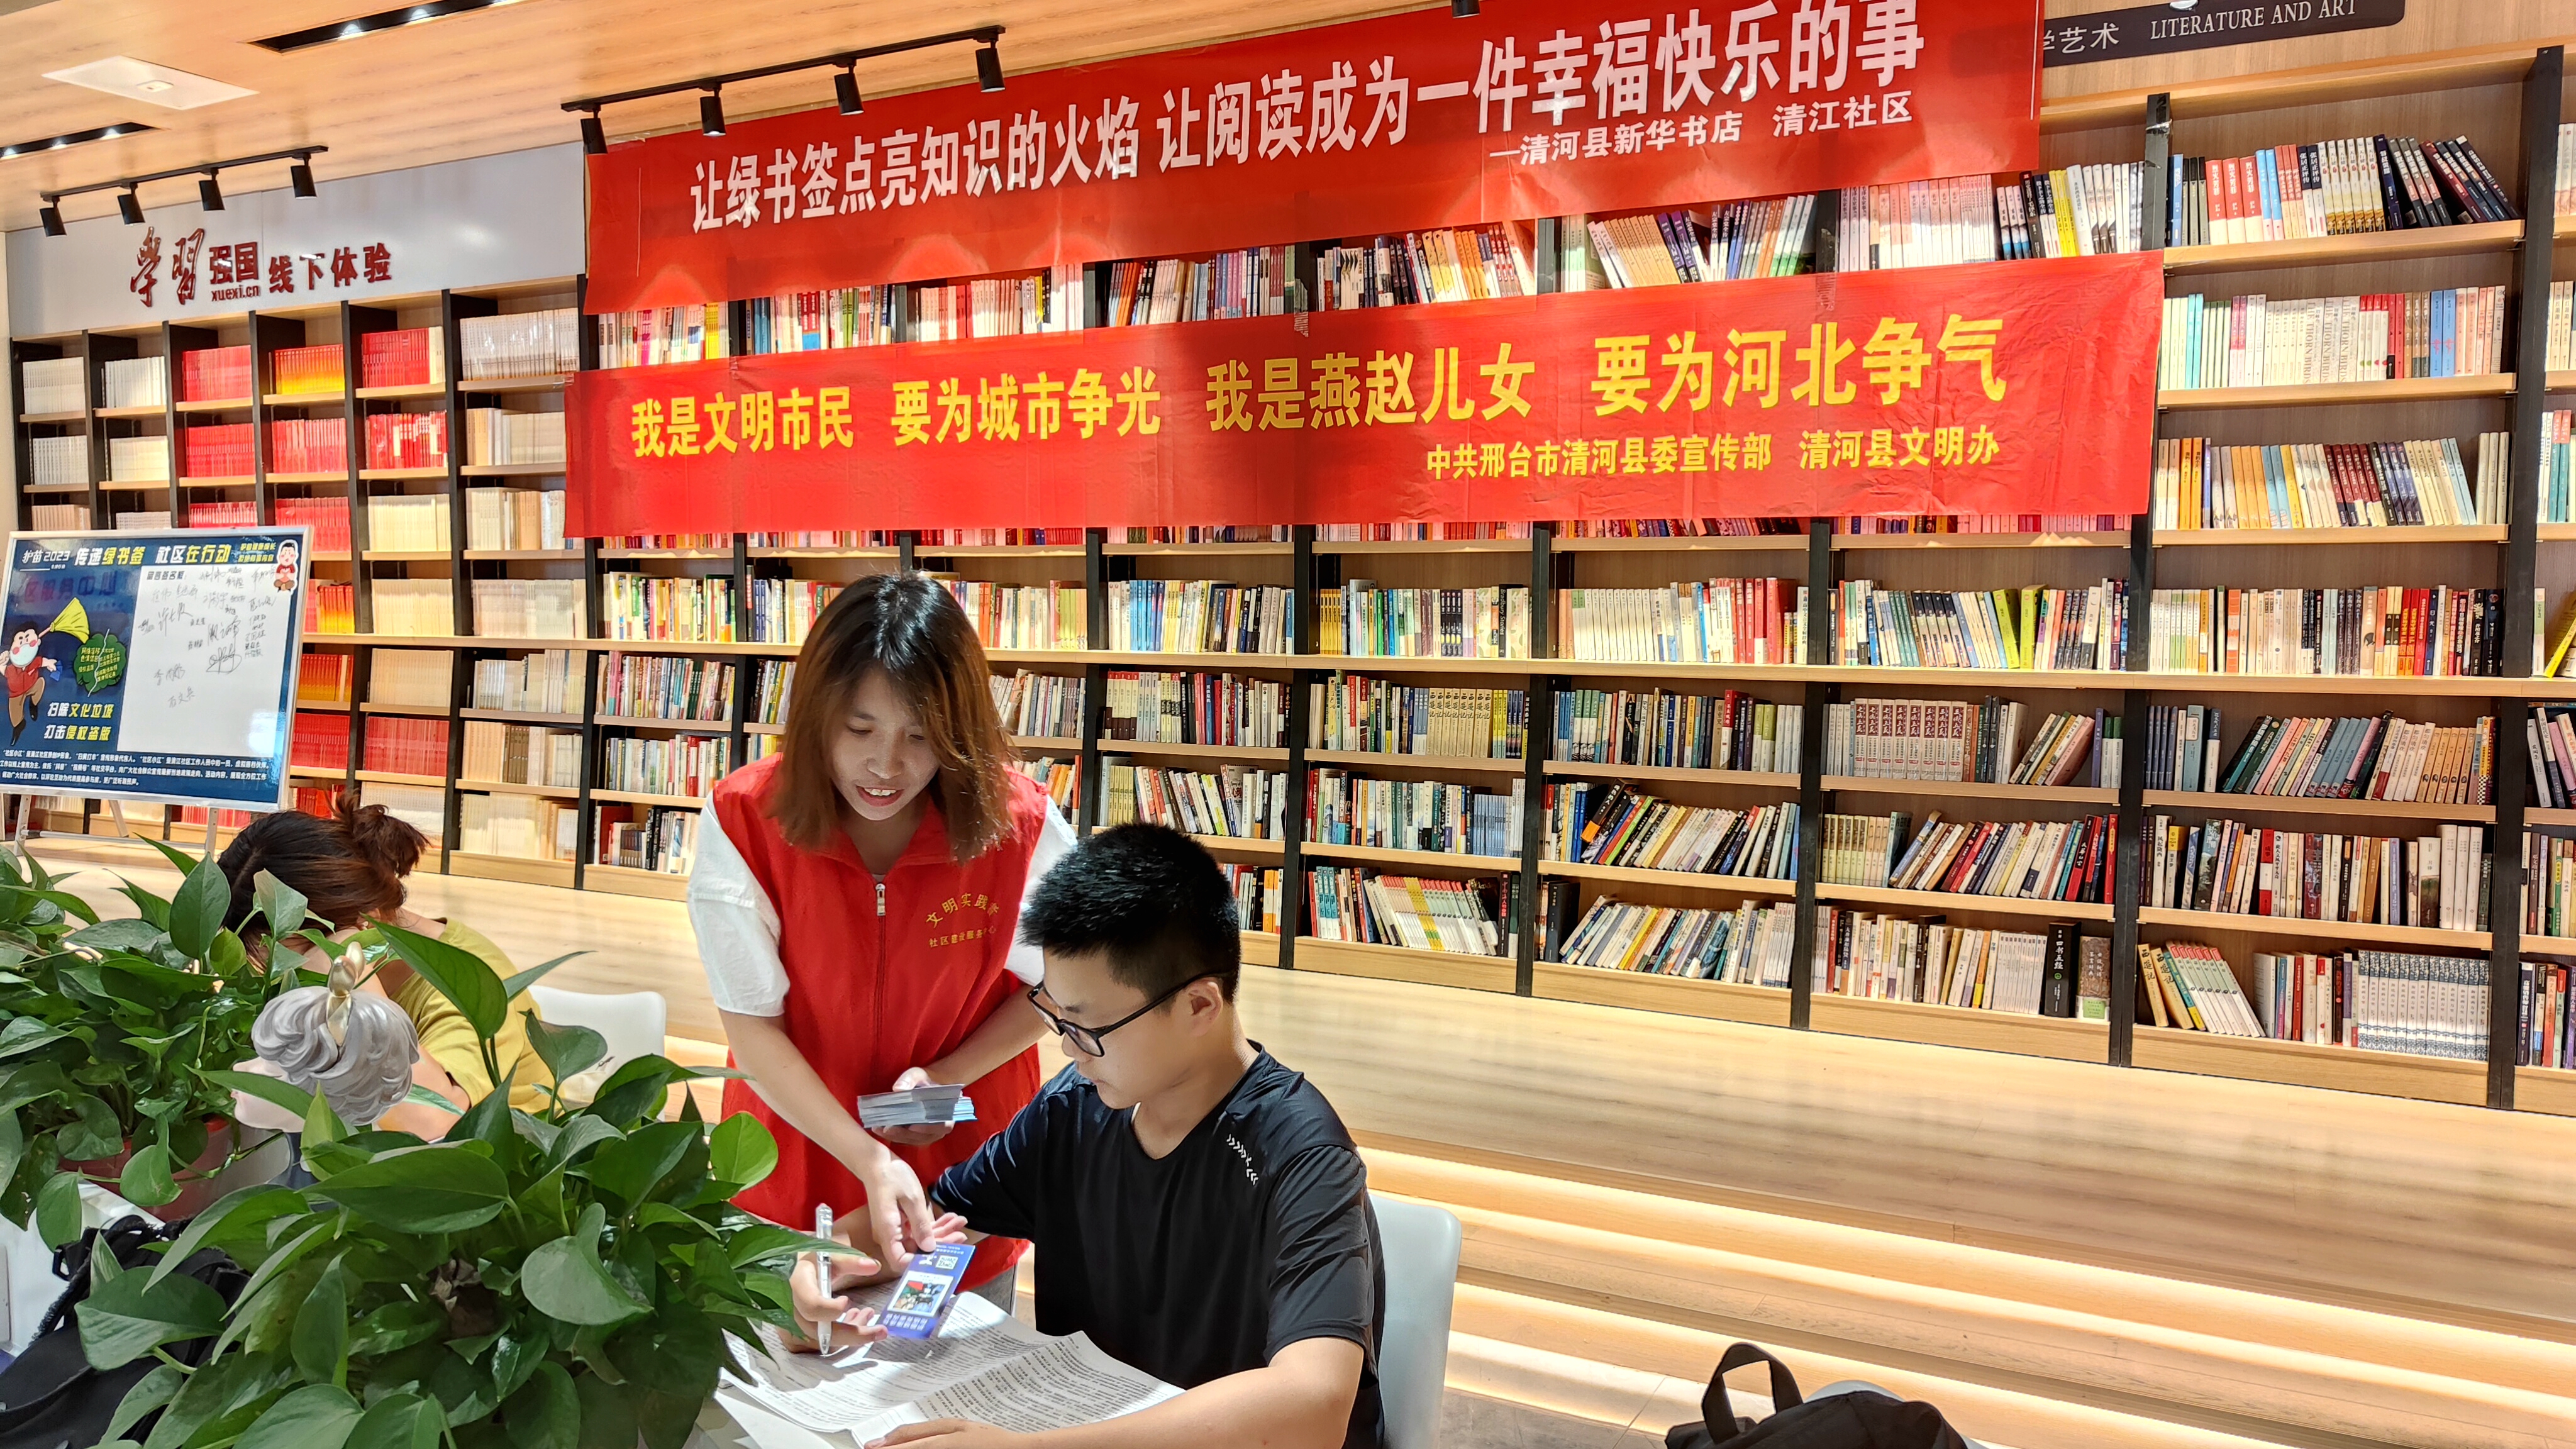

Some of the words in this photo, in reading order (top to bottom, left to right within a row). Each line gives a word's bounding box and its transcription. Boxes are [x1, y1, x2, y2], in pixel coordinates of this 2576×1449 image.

[2150, 8, 2265, 39] LITERATURE
[2270, 1, 2312, 24] AND
[2318, 0, 2358, 17] ART
[691, 94, 1140, 233] 让绿书签点亮知识的火焰
[1157, 0, 1925, 173] 让阅读成为一件幸福快乐的事
[1772, 91, 1913, 138] 清江社区
[269, 242, 392, 294] 线下体验
[211, 284, 260, 302] xuexi.cn
[2307, 302, 2316, 321] THE
[2306, 323, 2314, 355] THORN
[2324, 322, 2333, 353] THORN
[2341, 321, 2350, 352] THORN
[2303, 356, 2311, 384] BIRDS
[2339, 354, 2347, 382] BIRDS
[631, 386, 854, 457] 我是文明市民
[891, 366, 1162, 445] 要为城市争光
[1206, 343, 1536, 432] 我是燕赵儿女
[1591, 313, 2007, 416] 要为河北争气
[1426, 432, 1772, 480] 中共邢台市清河县委宣传部
[1799, 424, 2001, 472] 清河县文明办
[74, 547, 146, 566] 传递绿书签
[155, 544, 232, 564] 社区在行动
[47, 702, 115, 719] 扫除文化垃圾
[43, 724, 112, 741] 打击侵权盗版
[2053, 941, 2063, 970] 四书五经
